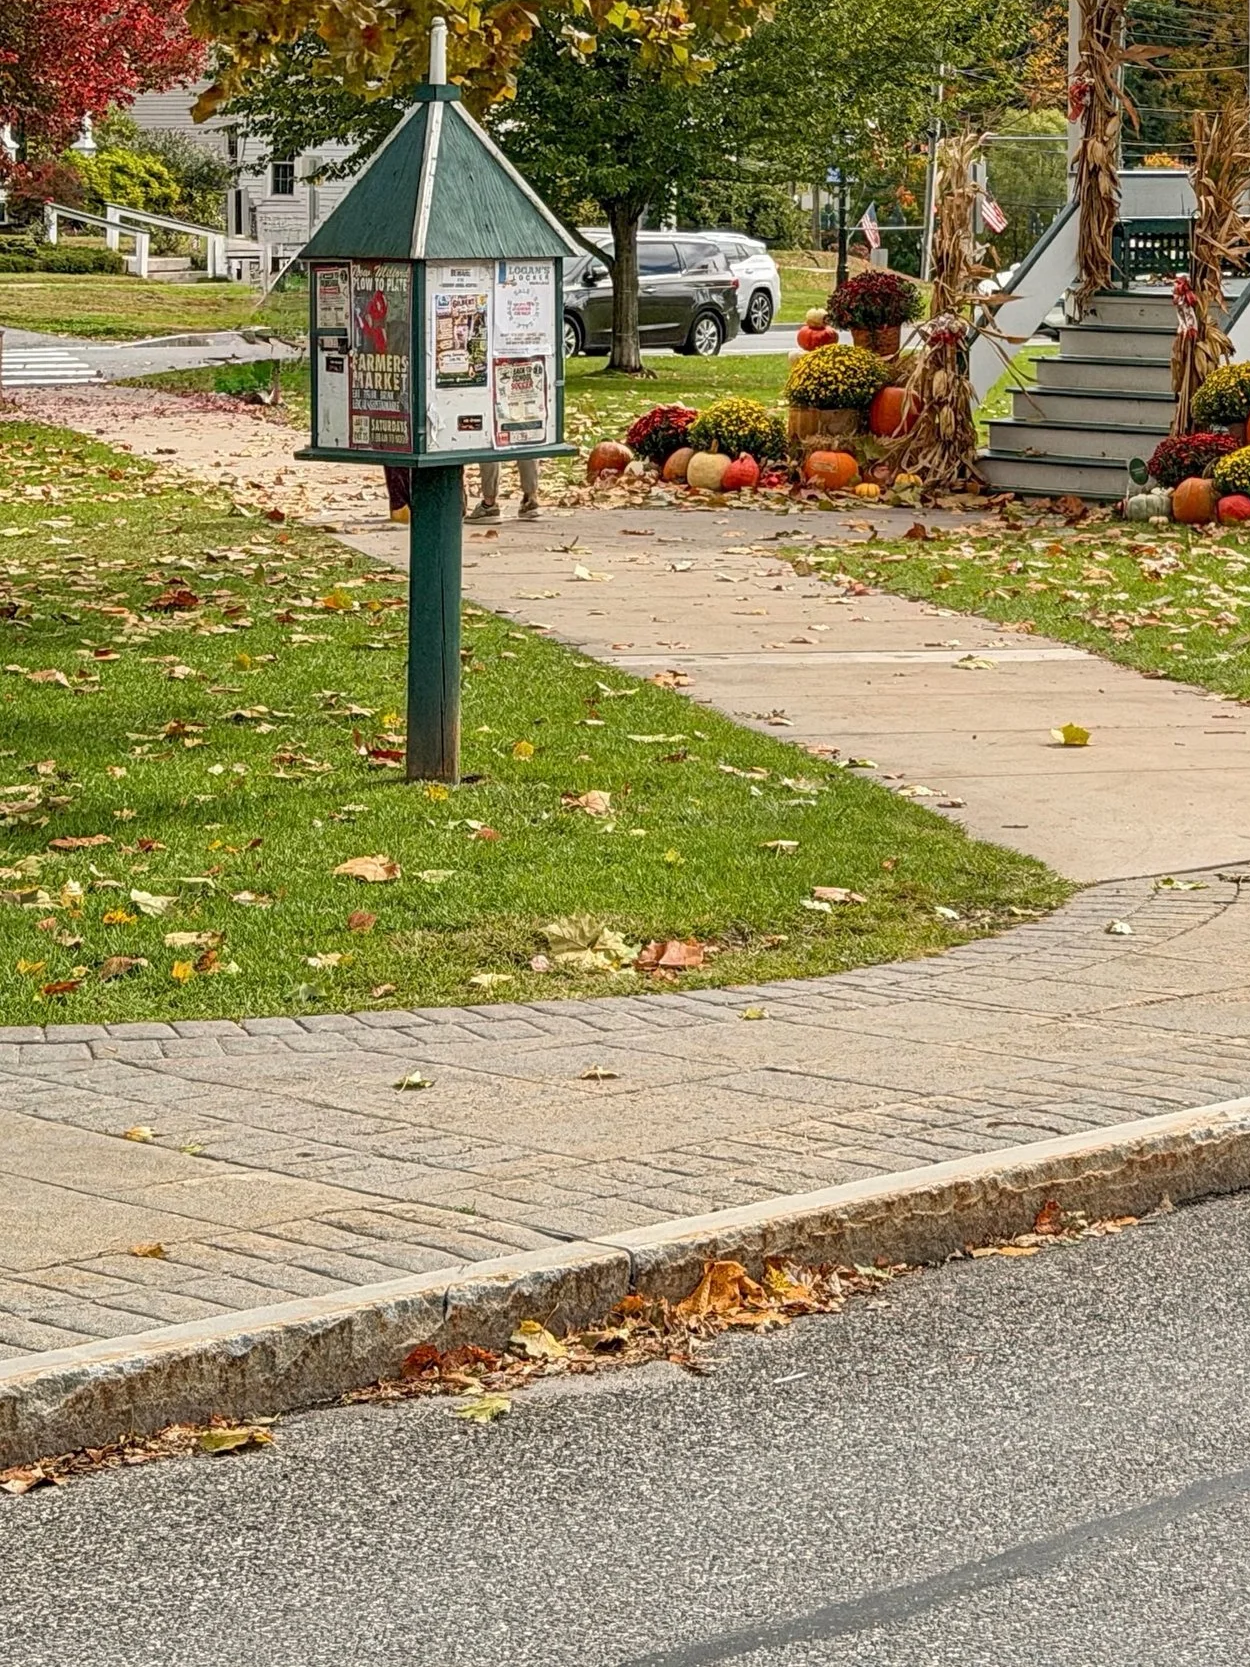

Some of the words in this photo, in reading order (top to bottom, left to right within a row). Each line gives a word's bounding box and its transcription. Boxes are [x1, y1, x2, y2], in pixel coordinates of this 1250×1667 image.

[509, 266, 550, 275] LOGAN'S
[353, 277, 373, 291] PLOW
[375, 277, 385, 291] TO
[387, 278, 407, 292] PLATE
[352, 353, 408, 373] FARMERS
[352, 371, 407, 392] MARKET
[371, 419, 408, 434] SATURDAYS
